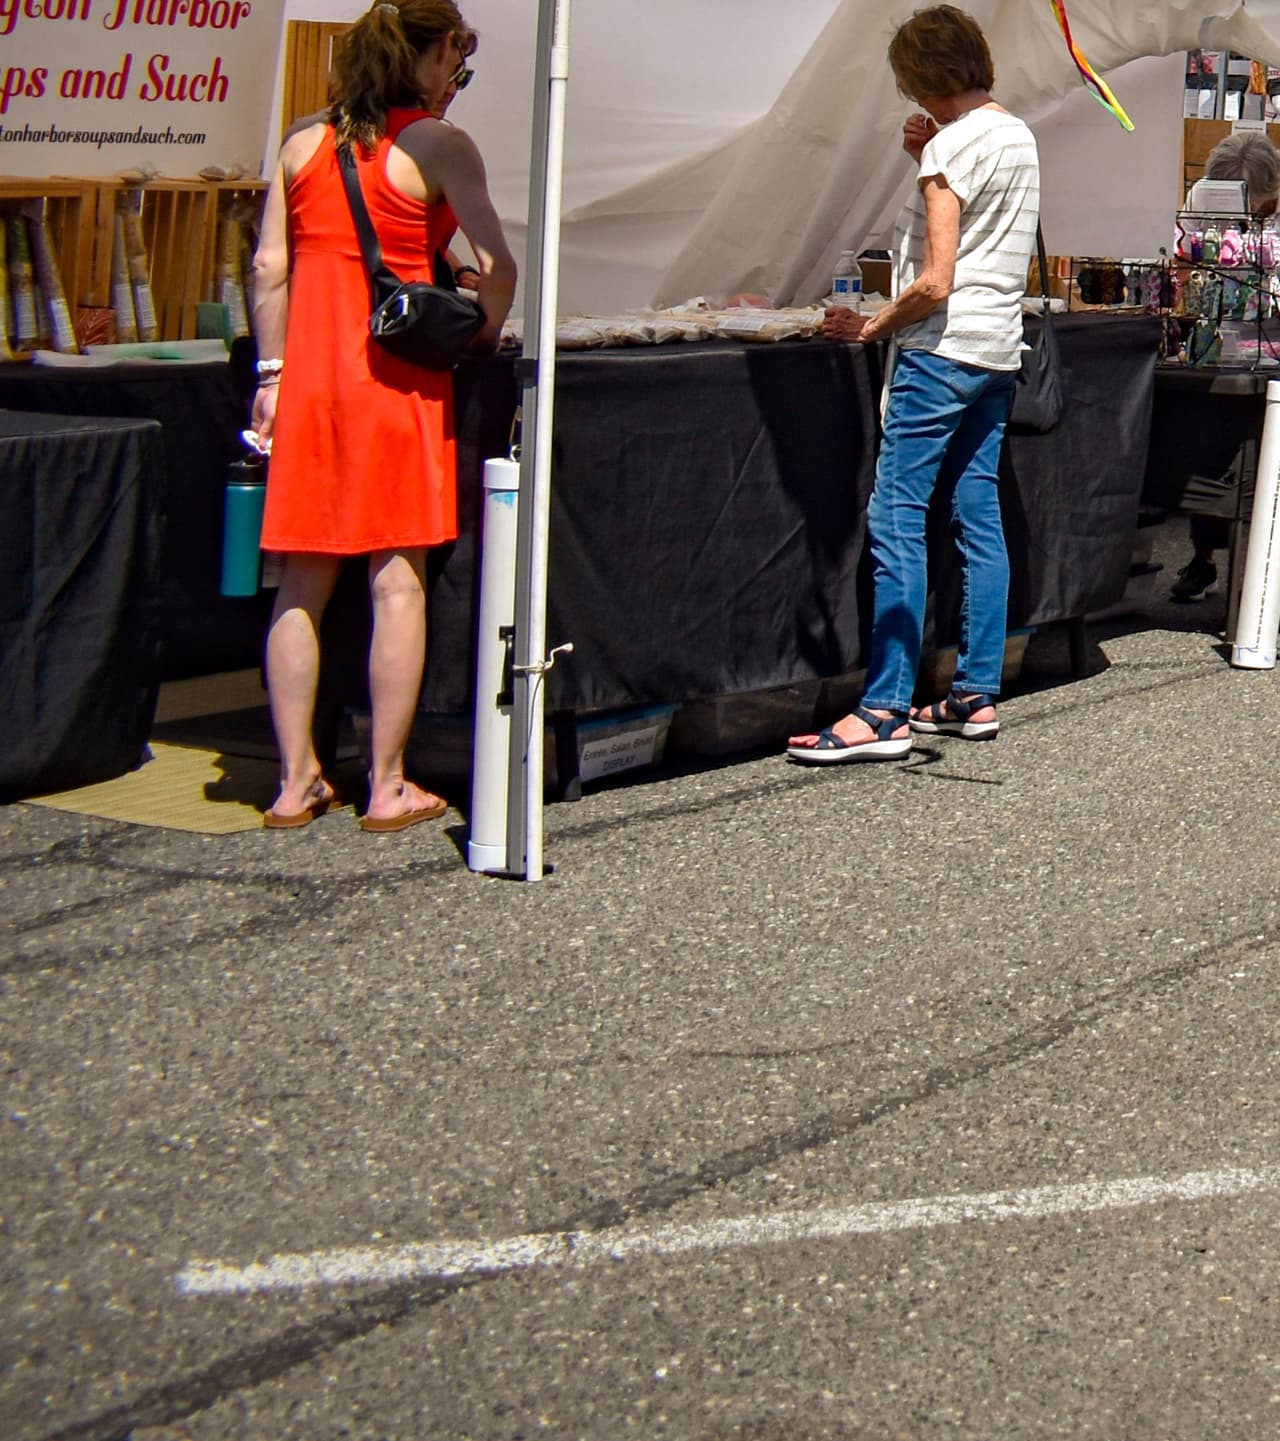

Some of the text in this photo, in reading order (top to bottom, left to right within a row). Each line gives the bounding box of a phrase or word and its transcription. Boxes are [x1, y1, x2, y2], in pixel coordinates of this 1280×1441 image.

[59, 53, 133, 100] and
[139, 54, 230, 102] Such
[602, 755, 636, 771] DISPLAY
